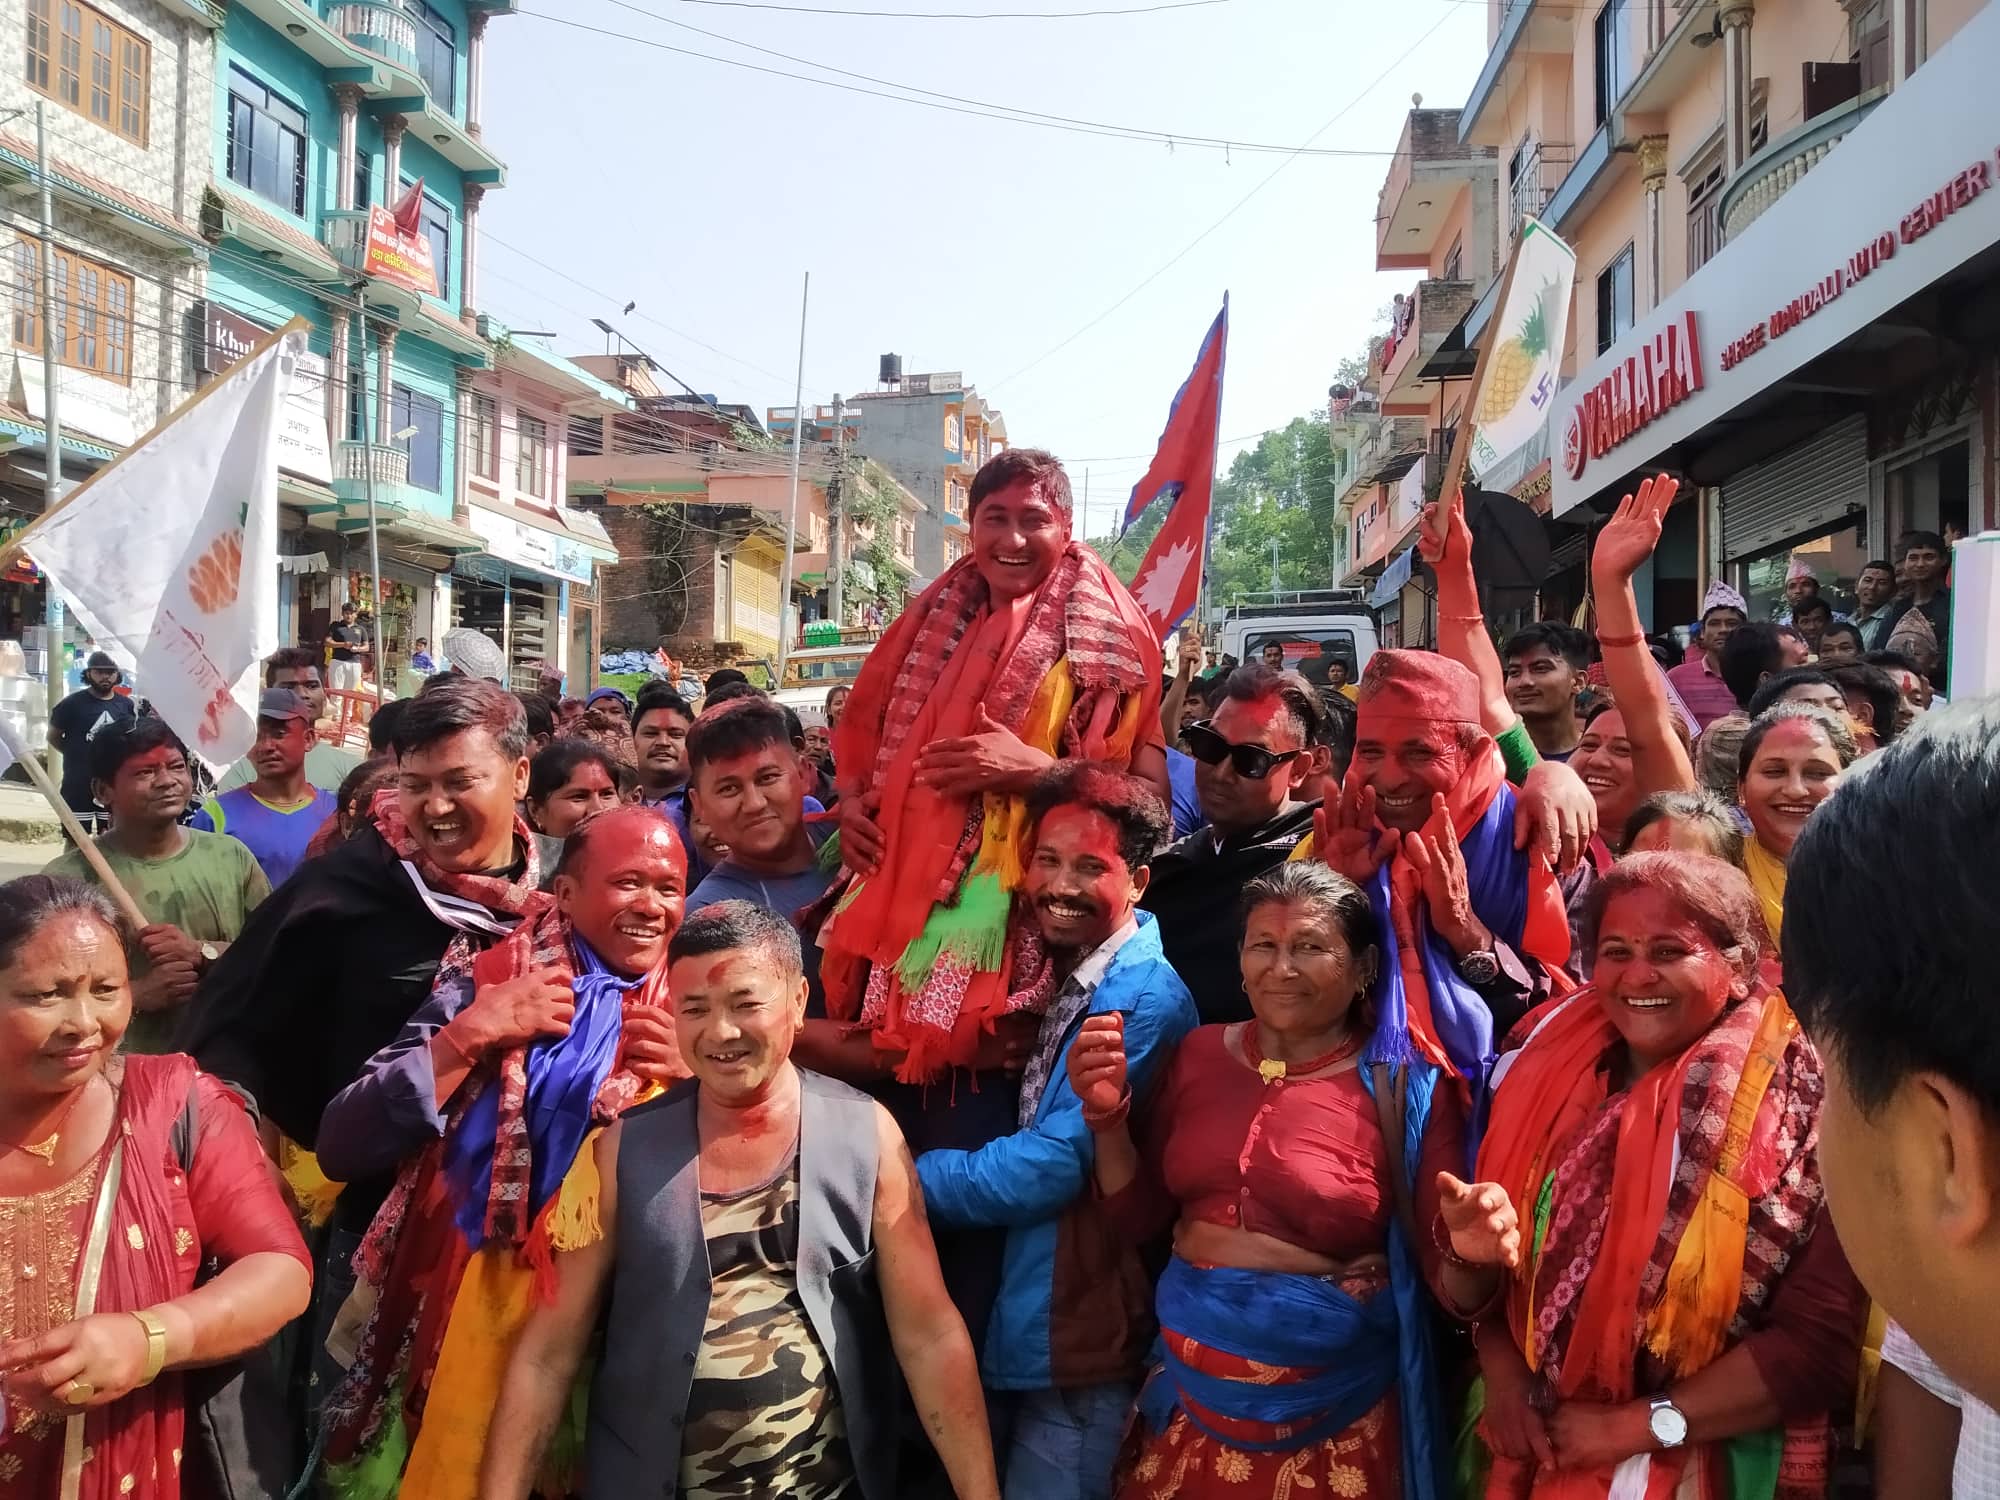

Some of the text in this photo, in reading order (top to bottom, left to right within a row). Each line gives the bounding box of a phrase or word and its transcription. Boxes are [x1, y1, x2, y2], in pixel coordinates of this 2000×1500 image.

[1720, 323, 1767, 371] SHREE
[1769, 269, 1843, 339] MANDALI
[1845, 231, 1898, 288] AUTO
[1900, 160, 1992, 244] CENTER
[1583, 310, 1704, 460] YAMAHA
